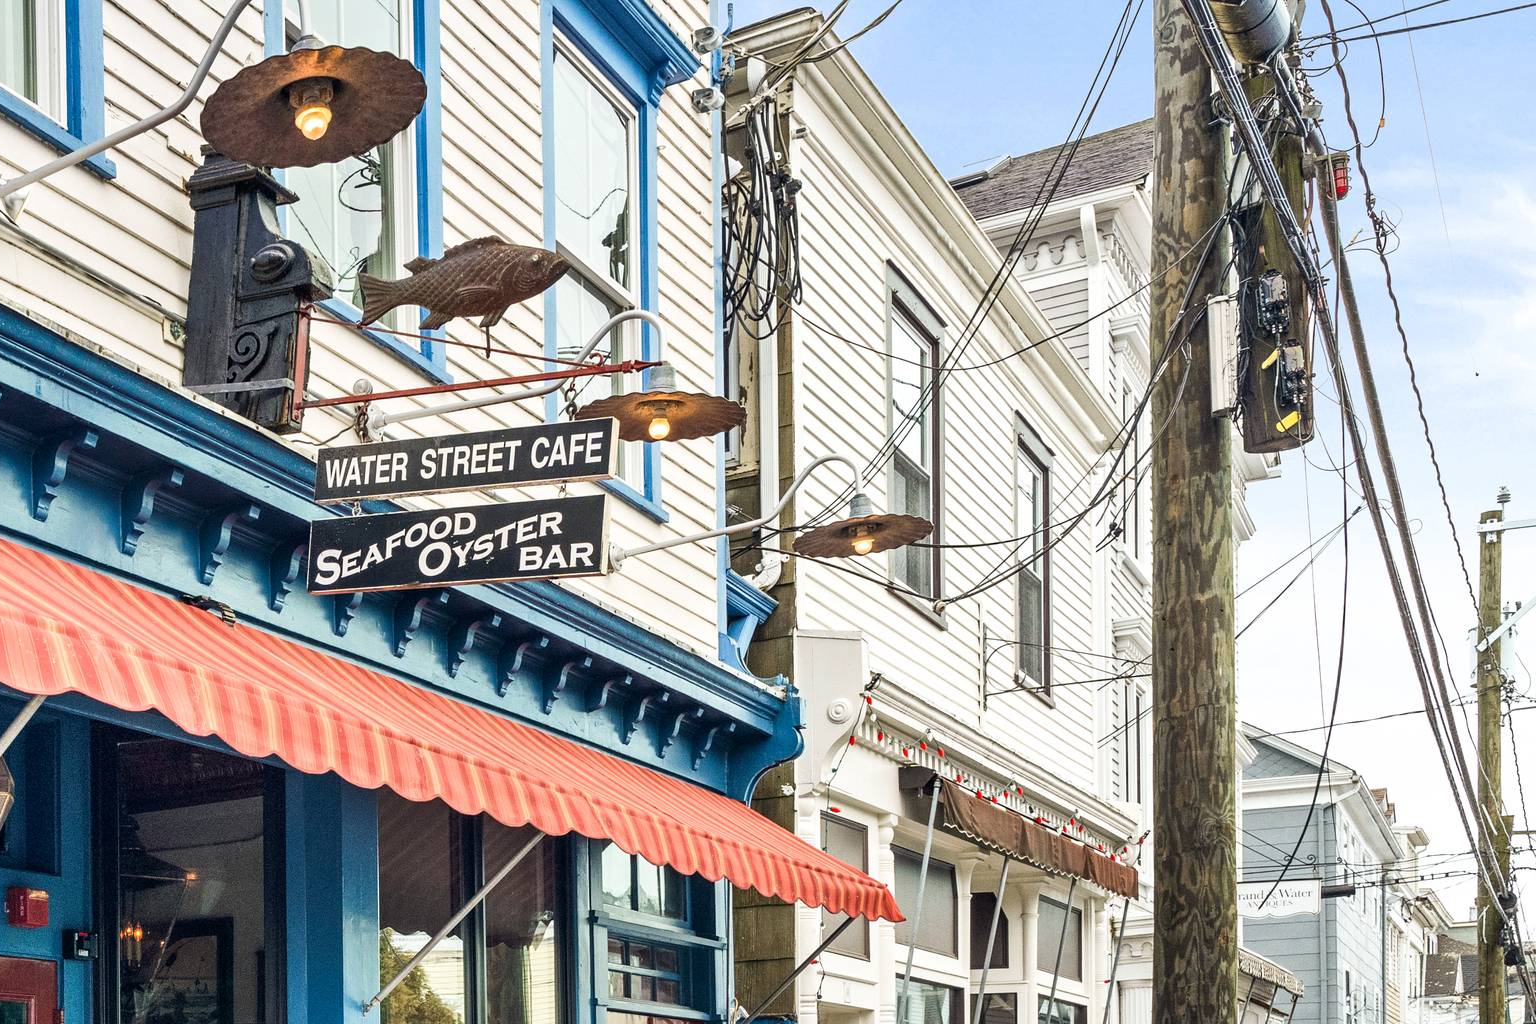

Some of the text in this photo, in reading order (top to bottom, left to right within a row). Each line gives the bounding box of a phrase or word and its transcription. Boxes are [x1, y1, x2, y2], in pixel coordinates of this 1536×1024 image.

[325, 431, 604, 488] WATER STREET CAFE
[314, 512, 477, 585] SEAFOOD
[418, 511, 563, 576] OYSTER
[519, 542, 594, 572] BAR
[1248, 900, 1294, 908] ANIQUES
[1279, 888, 1312, 898] Water
